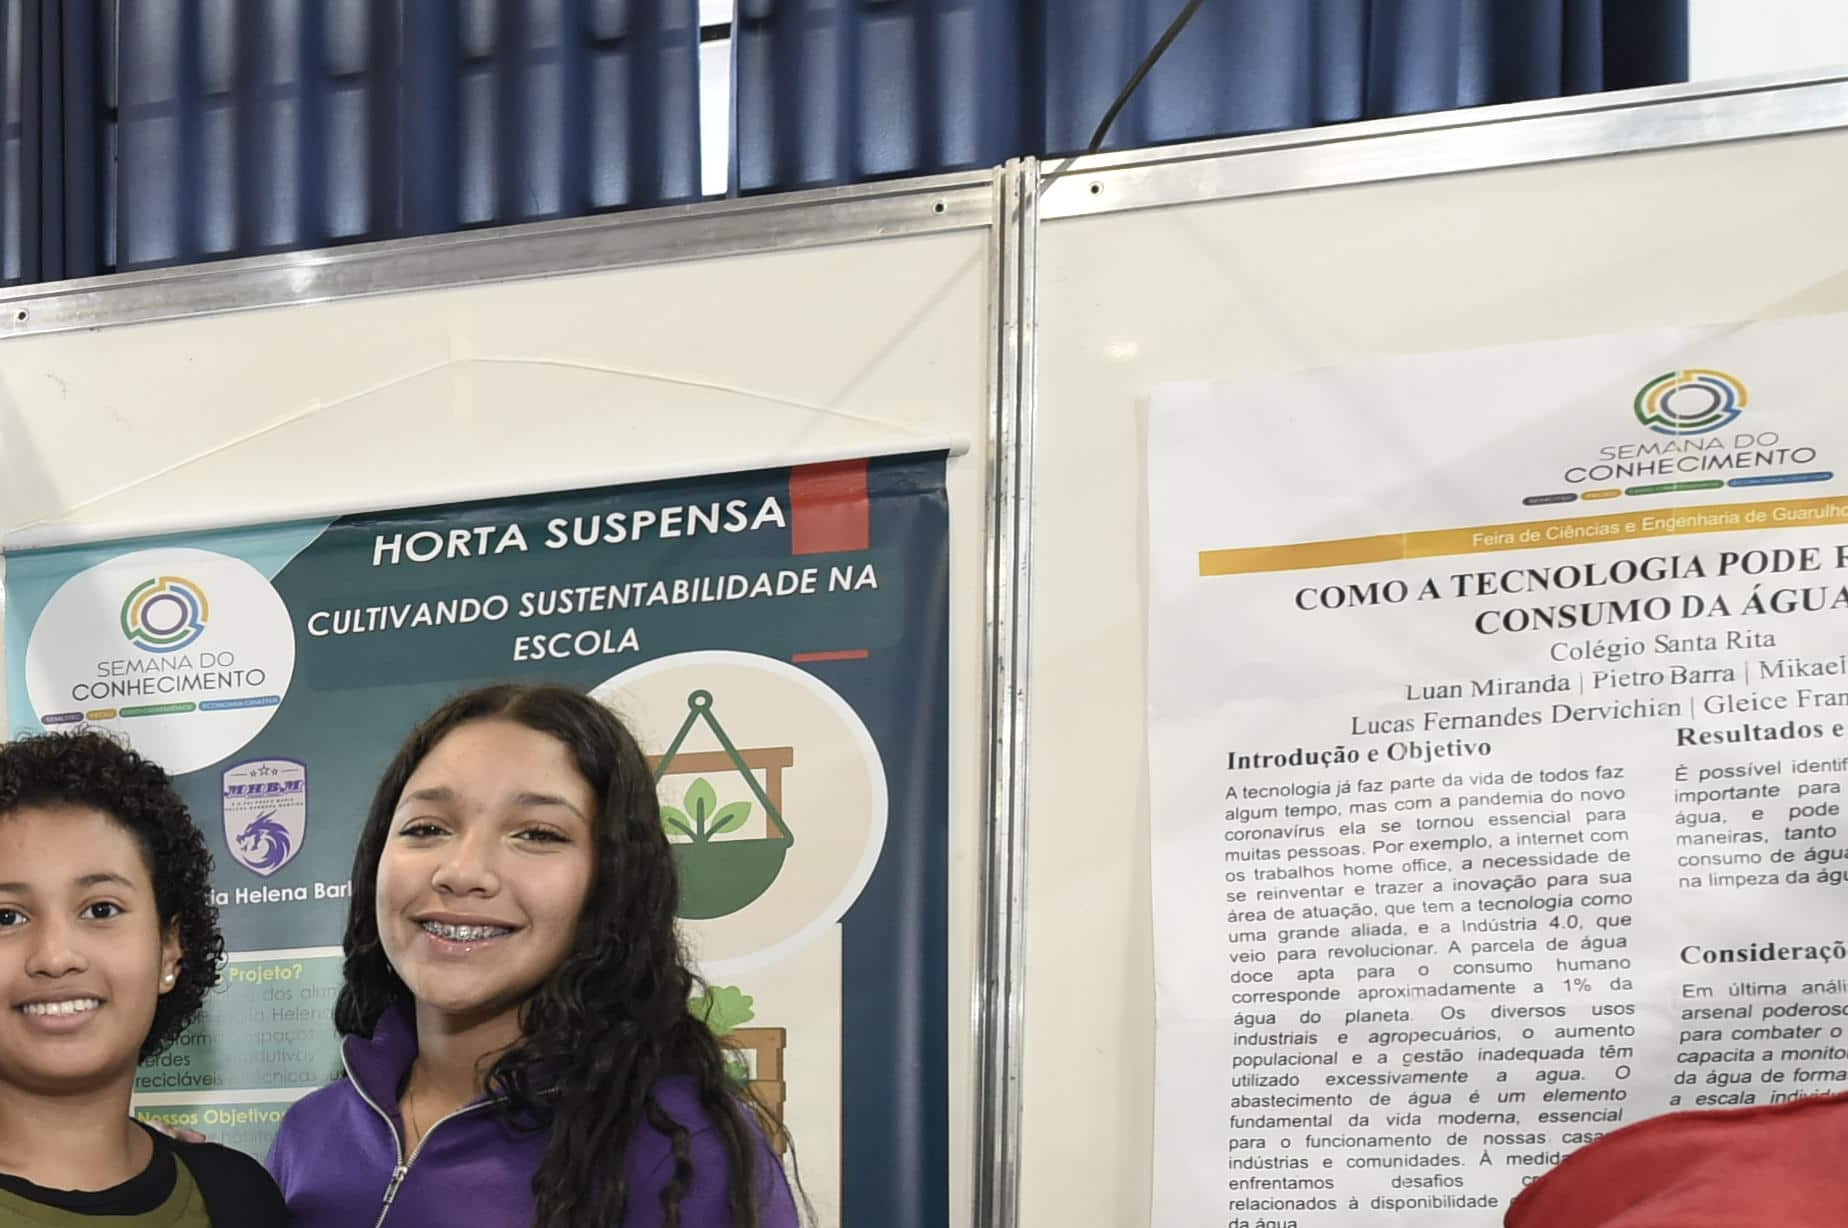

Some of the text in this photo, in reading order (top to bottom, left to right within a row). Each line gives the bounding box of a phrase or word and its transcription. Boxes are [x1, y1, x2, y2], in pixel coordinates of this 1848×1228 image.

[1600, 432, 1779, 461] SEMANA DO
[1564, 447, 1817, 483] CONHECIMENTO
[373, 493, 786, 566] HORTA SUSPENSA
[1472, 532, 1515, 546] Feira
[1519, 529, 1541, 543] de
[1545, 523, 1620, 540] Ciências
[1624, 522, 1637, 533] e
[1642, 513, 1740, 532] Engenharia
[1744, 510, 1767, 523] de
[1295, 580, 1408, 611] COMO
[1416, 577, 1442, 601] A
[1450, 554, 1707, 598] TECNOLOGIA
[1717, 547, 1822, 576] PODE
[308, 564, 877, 636] CULTIVANDO SUSTENTABILIDADE NA
[1475, 583, 1848, 635] CONSUMO DA ÁGUA
[513, 627, 639, 661] ESCOLA
[1551, 630, 1776, 662] Colégio Santa Rita
[97, 651, 234, 677] SEMANA DO
[72, 669, 266, 701] CONHECIMENTO
[1405, 684, 1462, 701] Luan
[1470, 674, 1571, 697] Miranda
[1592, 671, 1664, 689] Pietro
[1669, 665, 1735, 684] Barra
[1352, 716, 1415, 735] Lucas
[1424, 707, 1542, 731] Fernandes
[1552, 699, 1680, 723] Dervichian
[1704, 694, 1787, 714] Gleice
[1677, 721, 1844, 746] Resultados e
[1227, 739, 1491, 770] Introdução e Objetivo
[1675, 764, 1688, 781] É
[1699, 760, 1781, 783] possível
[1675, 783, 1840, 805] importante para
[1752, 810, 1764, 820] e
[1789, 802, 1839, 821] pode
[1225, 810, 1626, 841] coronavírus ela se tornou essencial para
[1785, 825, 1837, 840] tanto
[1678, 853, 1762, 867] consumo
[1770, 849, 1795, 863] de
[1679, 877, 1702, 888] na
[1709, 873, 1779, 888] limpeza
[1786, 870, 1809, 884] da
[235, 885, 307, 905] Helena
[1680, 940, 1846, 964] Consideraçõ
[229, 964, 302, 984] Projeto?
[1231, 958, 1631, 983] doce apta para o consumo humano
[1232, 977, 1632, 1005] corresponde aproximadamente a 1% da
[1683, 984, 1713, 998] Em
[1729, 982, 1786, 996] última
[1234, 1012, 1276, 1028] água
[1300, 1010, 1321, 1024] do
[1441, 1006, 1466, 1020] Os
[1491, 1005, 1566, 1018] diversos
[1592, 1004, 1636, 1016] usos
[1681, 1004, 1752, 1020] arsenal
[1234, 1032, 1318, 1046] industriais
[1338, 1033, 1348, 1044] e
[1522, 1028, 1534, 1039] o
[1555, 1024, 1635, 1038] aumento
[1680, 1025, 1842, 1045] para combater o
[1677, 1046, 1848, 1066] capacita a monito
[1674, 1071, 1696, 1084] da
[1706, 1070, 1752, 1087] água
[1761, 1069, 1784, 1083] de
[1231, 1088, 1627, 1108] abastecimento de água é um elemento
[1669, 1095, 1681, 1105] a
[1696, 1091, 1756, 1105] escala
[1230, 1114, 1332, 1128] fundamental
[1348, 1113, 1369, 1127] da
[1386, 1112, 1421, 1126] vida
[1538, 1107, 1623, 1123] essencial
[1229, 1174, 1464, 1190] enfrentamos desafios
[1229, 1194, 1498, 1212] relacionados à disponibilidade
